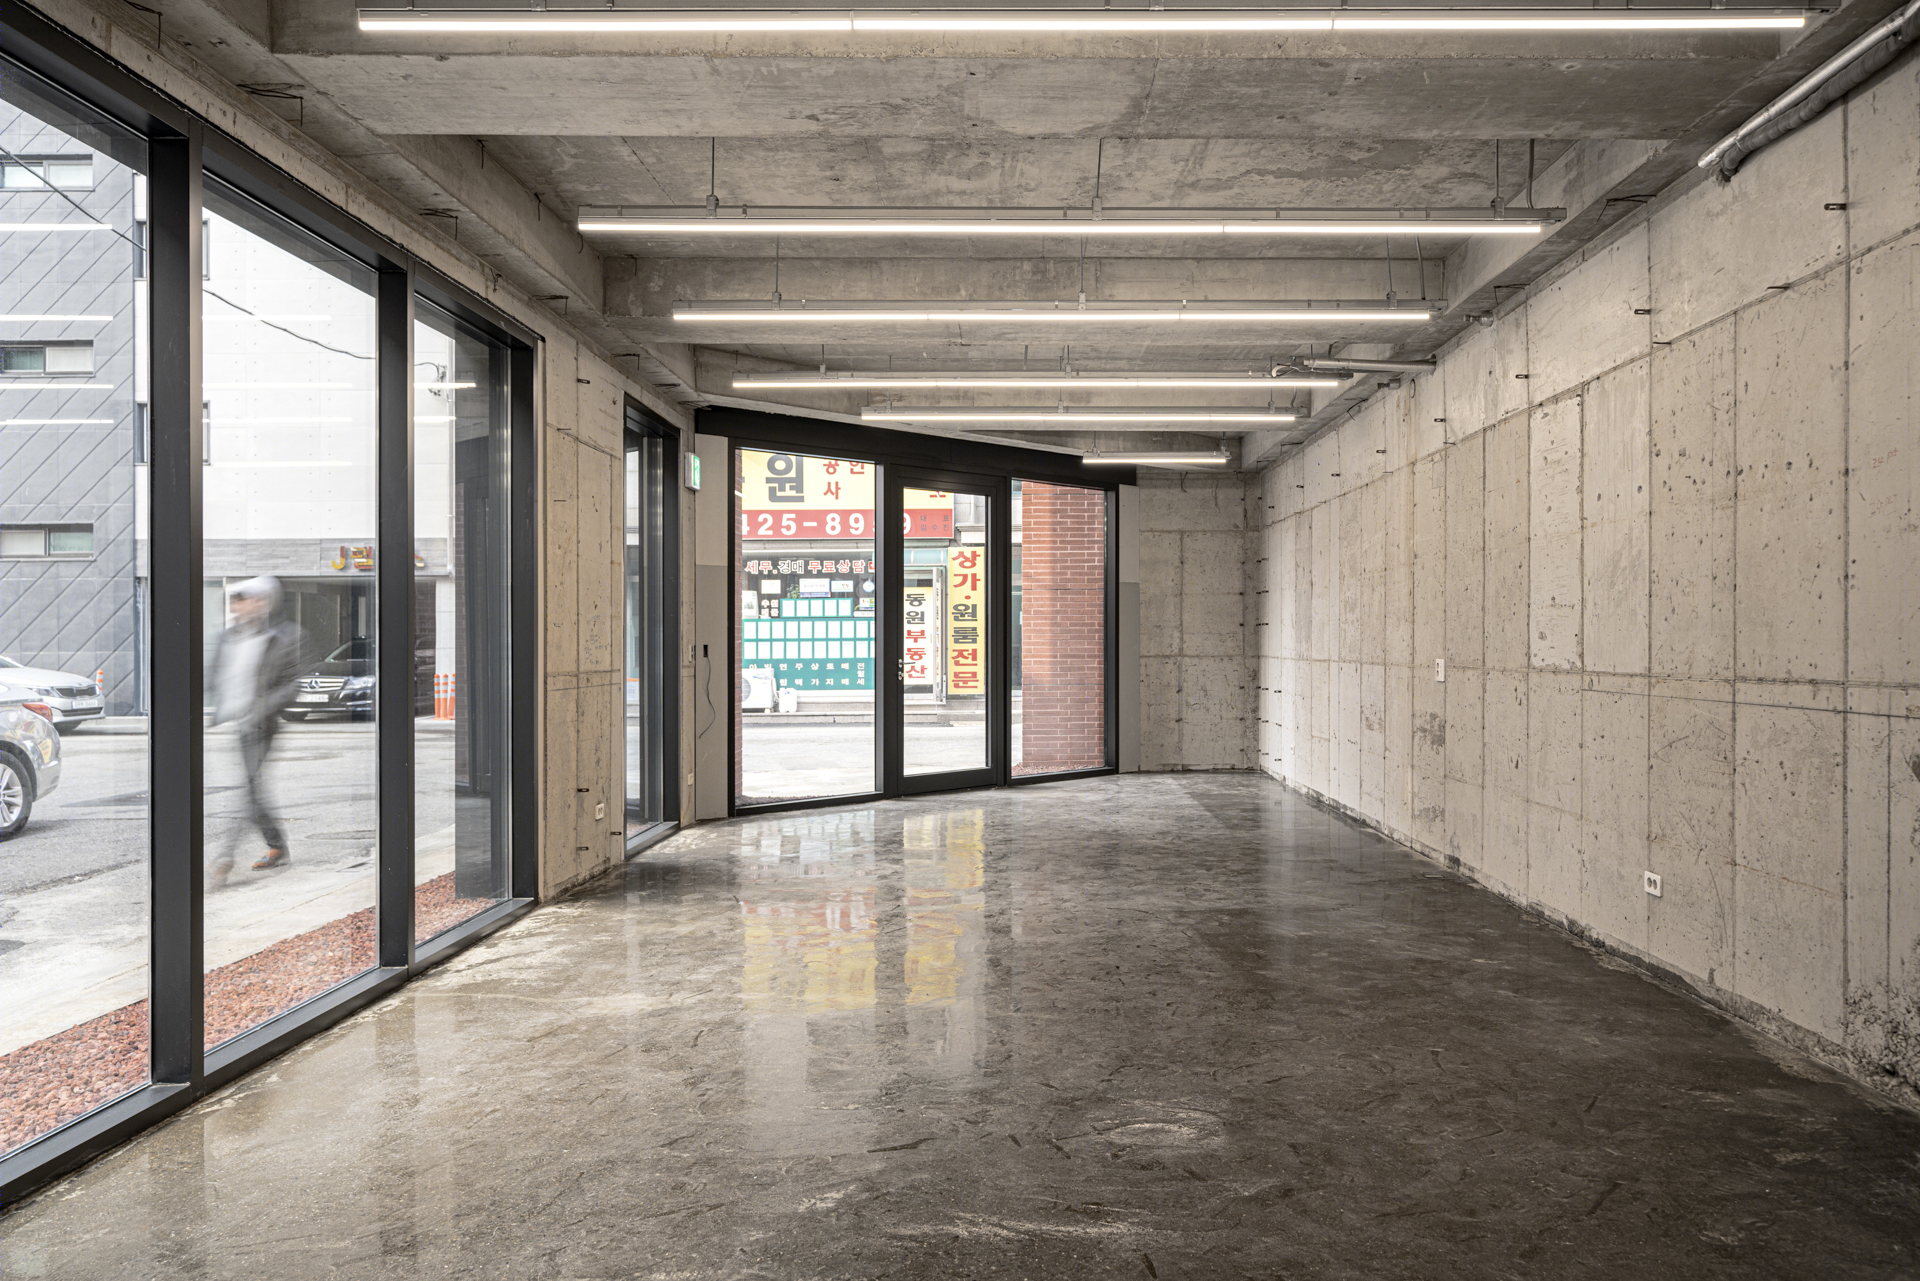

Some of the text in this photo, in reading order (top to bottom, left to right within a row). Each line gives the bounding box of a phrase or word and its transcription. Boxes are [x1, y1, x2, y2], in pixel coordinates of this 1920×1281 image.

[745, 560, 804, 574] 세무.경매
[808, 560, 865, 573] 무료상담
[905, 594, 927, 678] 동원부동산
